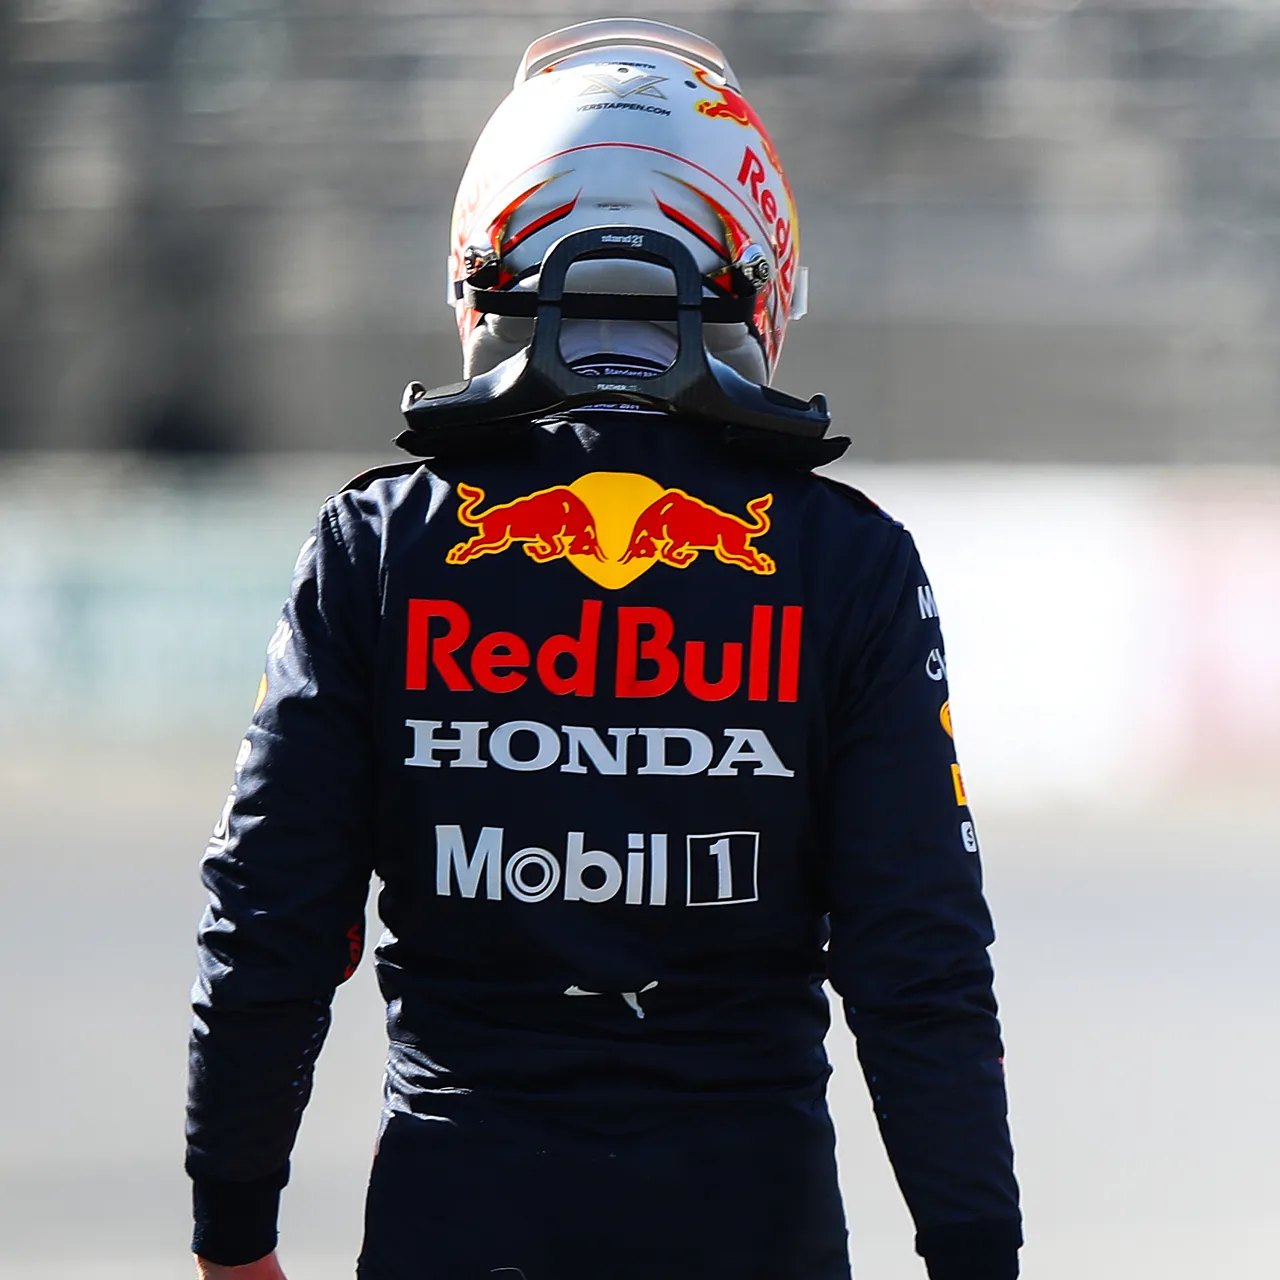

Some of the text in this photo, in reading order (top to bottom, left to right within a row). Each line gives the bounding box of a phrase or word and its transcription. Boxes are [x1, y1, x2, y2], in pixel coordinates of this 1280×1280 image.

[577, 102, 672, 117] VERSTAPPEN.COM
[405, 598, 603, 697] Red
[615, 604, 803, 703] Bull
[404, 719, 795, 778] HONDA
[434, 824, 734, 906] Mobil 1
